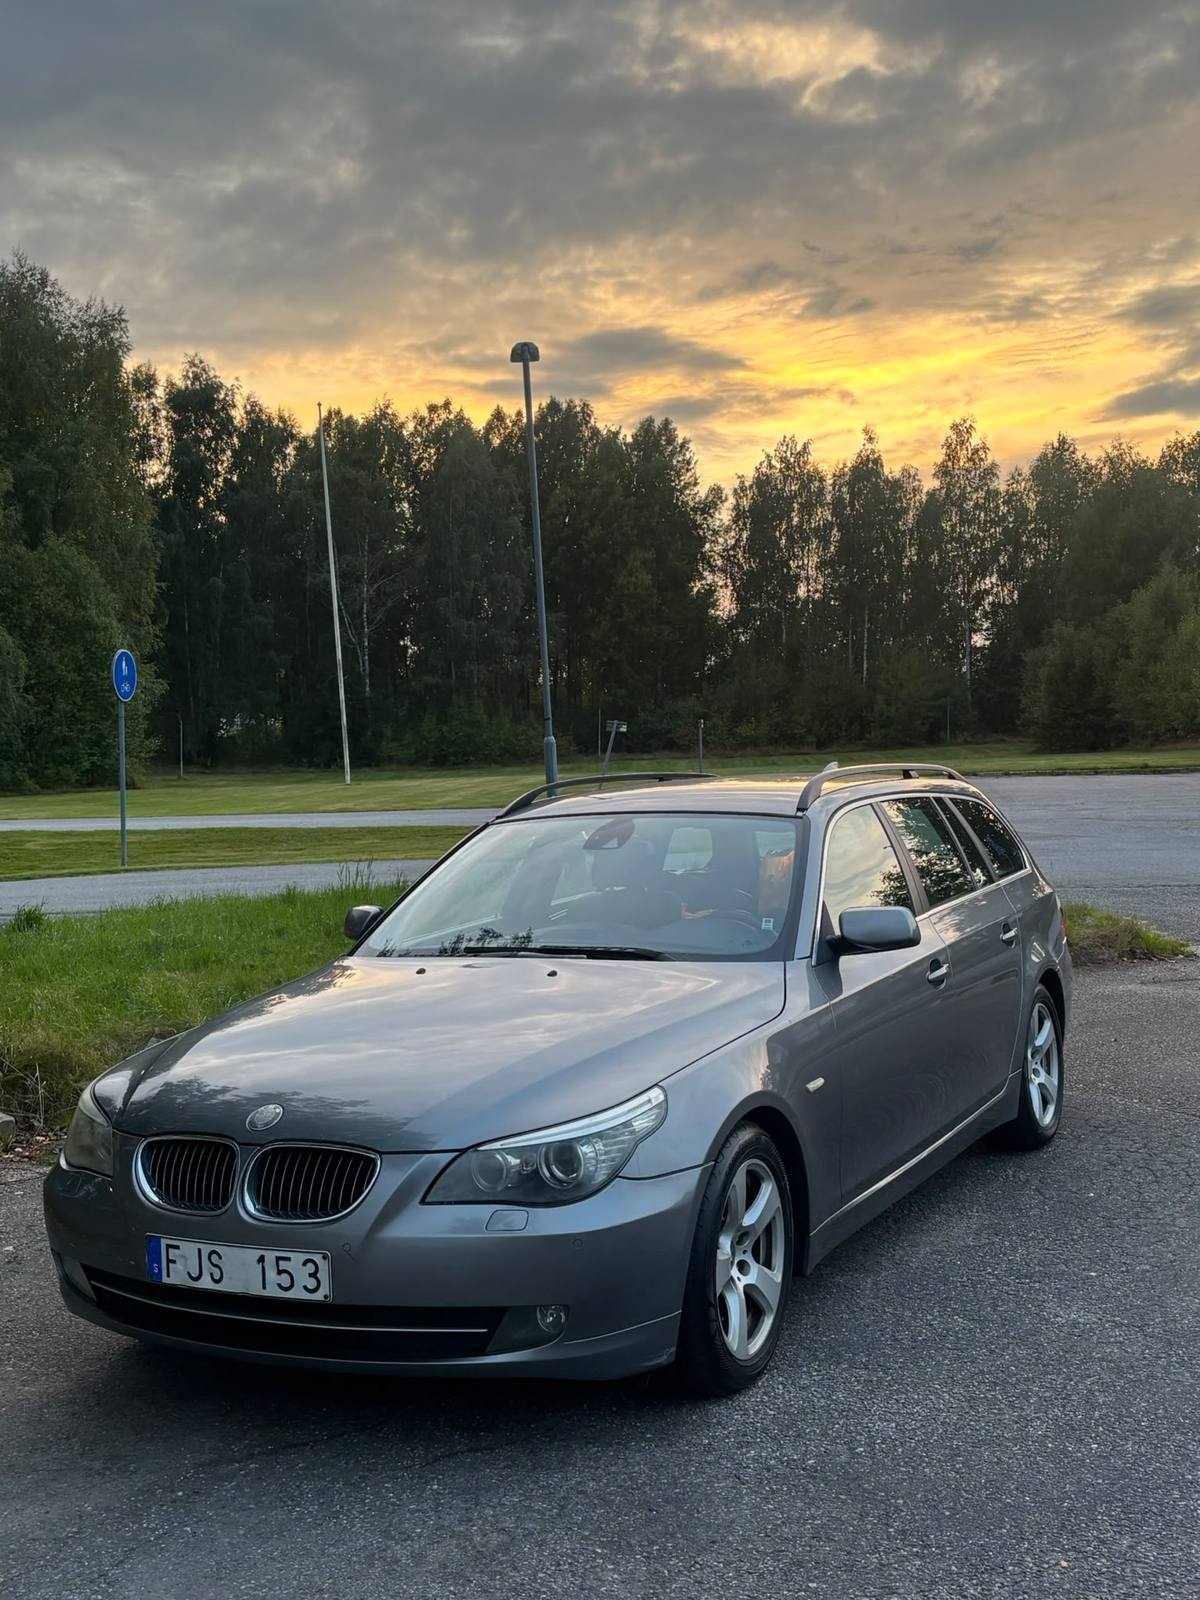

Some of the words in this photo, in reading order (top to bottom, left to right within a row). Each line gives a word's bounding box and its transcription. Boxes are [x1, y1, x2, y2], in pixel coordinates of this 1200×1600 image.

[153, 1263, 159, 1273] S
[165, 1243, 224, 1284] FJS
[256, 1254, 321, 1294] 153
